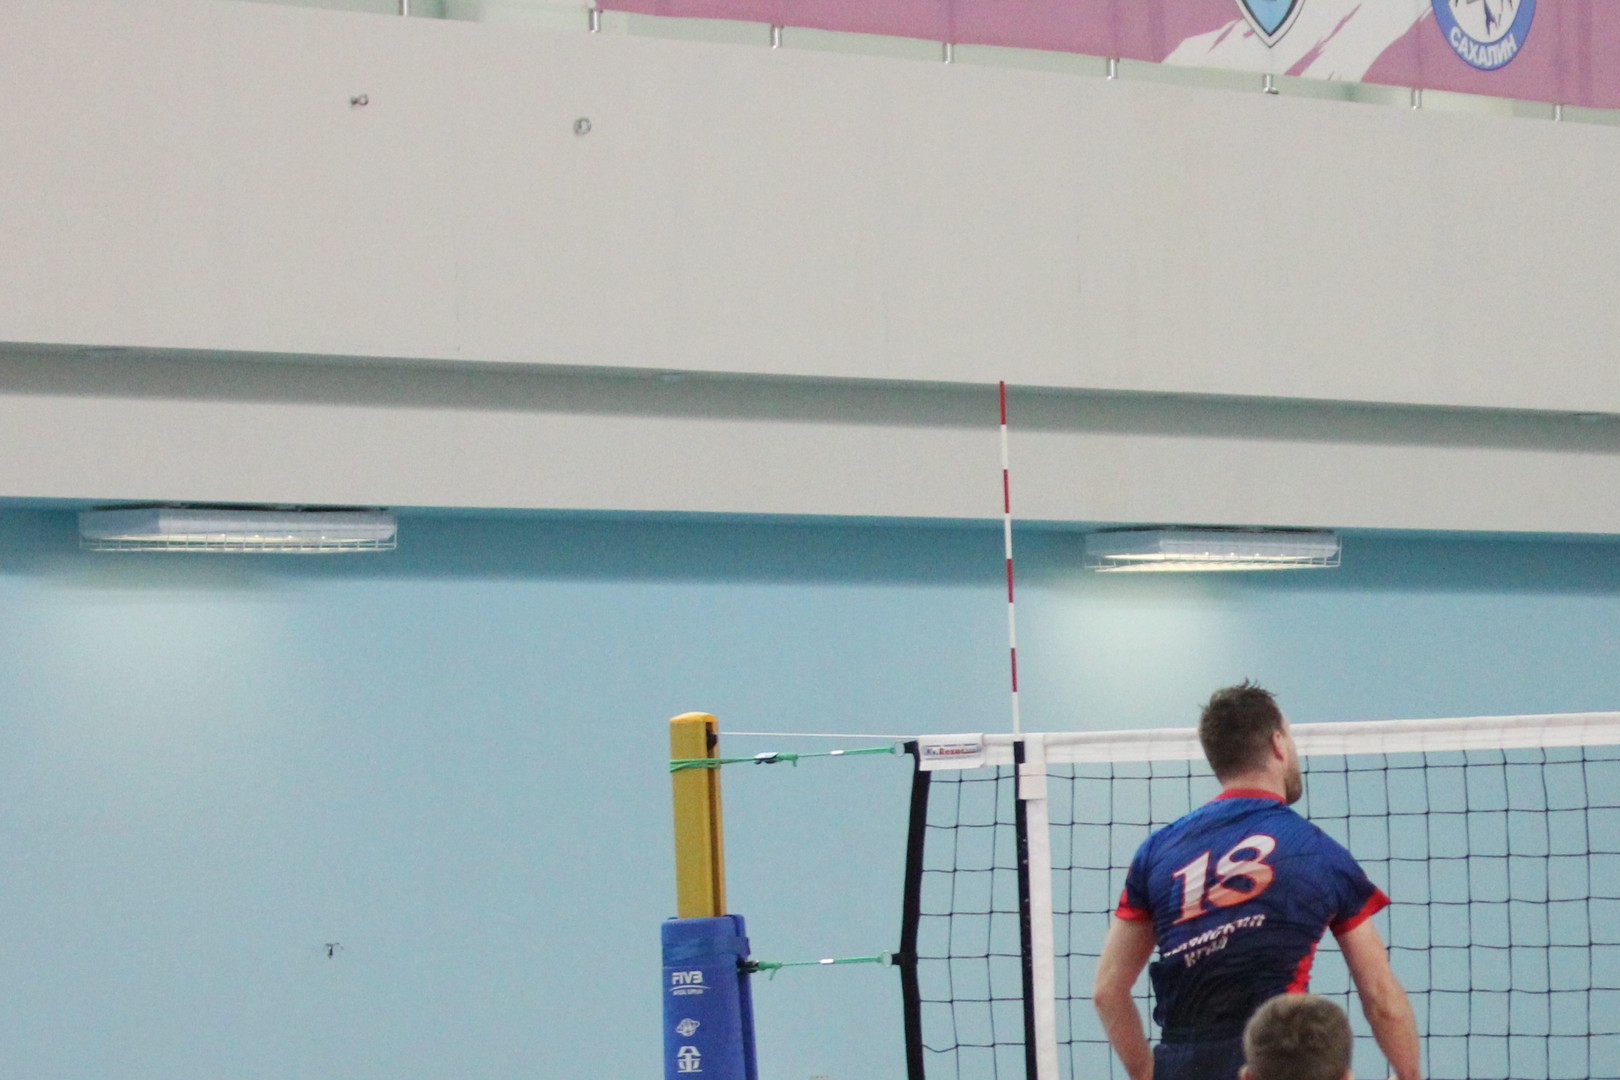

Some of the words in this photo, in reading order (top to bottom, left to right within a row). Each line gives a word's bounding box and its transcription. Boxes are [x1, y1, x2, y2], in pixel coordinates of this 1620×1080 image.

[1450, 25, 1518, 67] САХАЛИН
[1171, 833, 1277, 926] 18
[672, 970, 703, 985] FIVB
